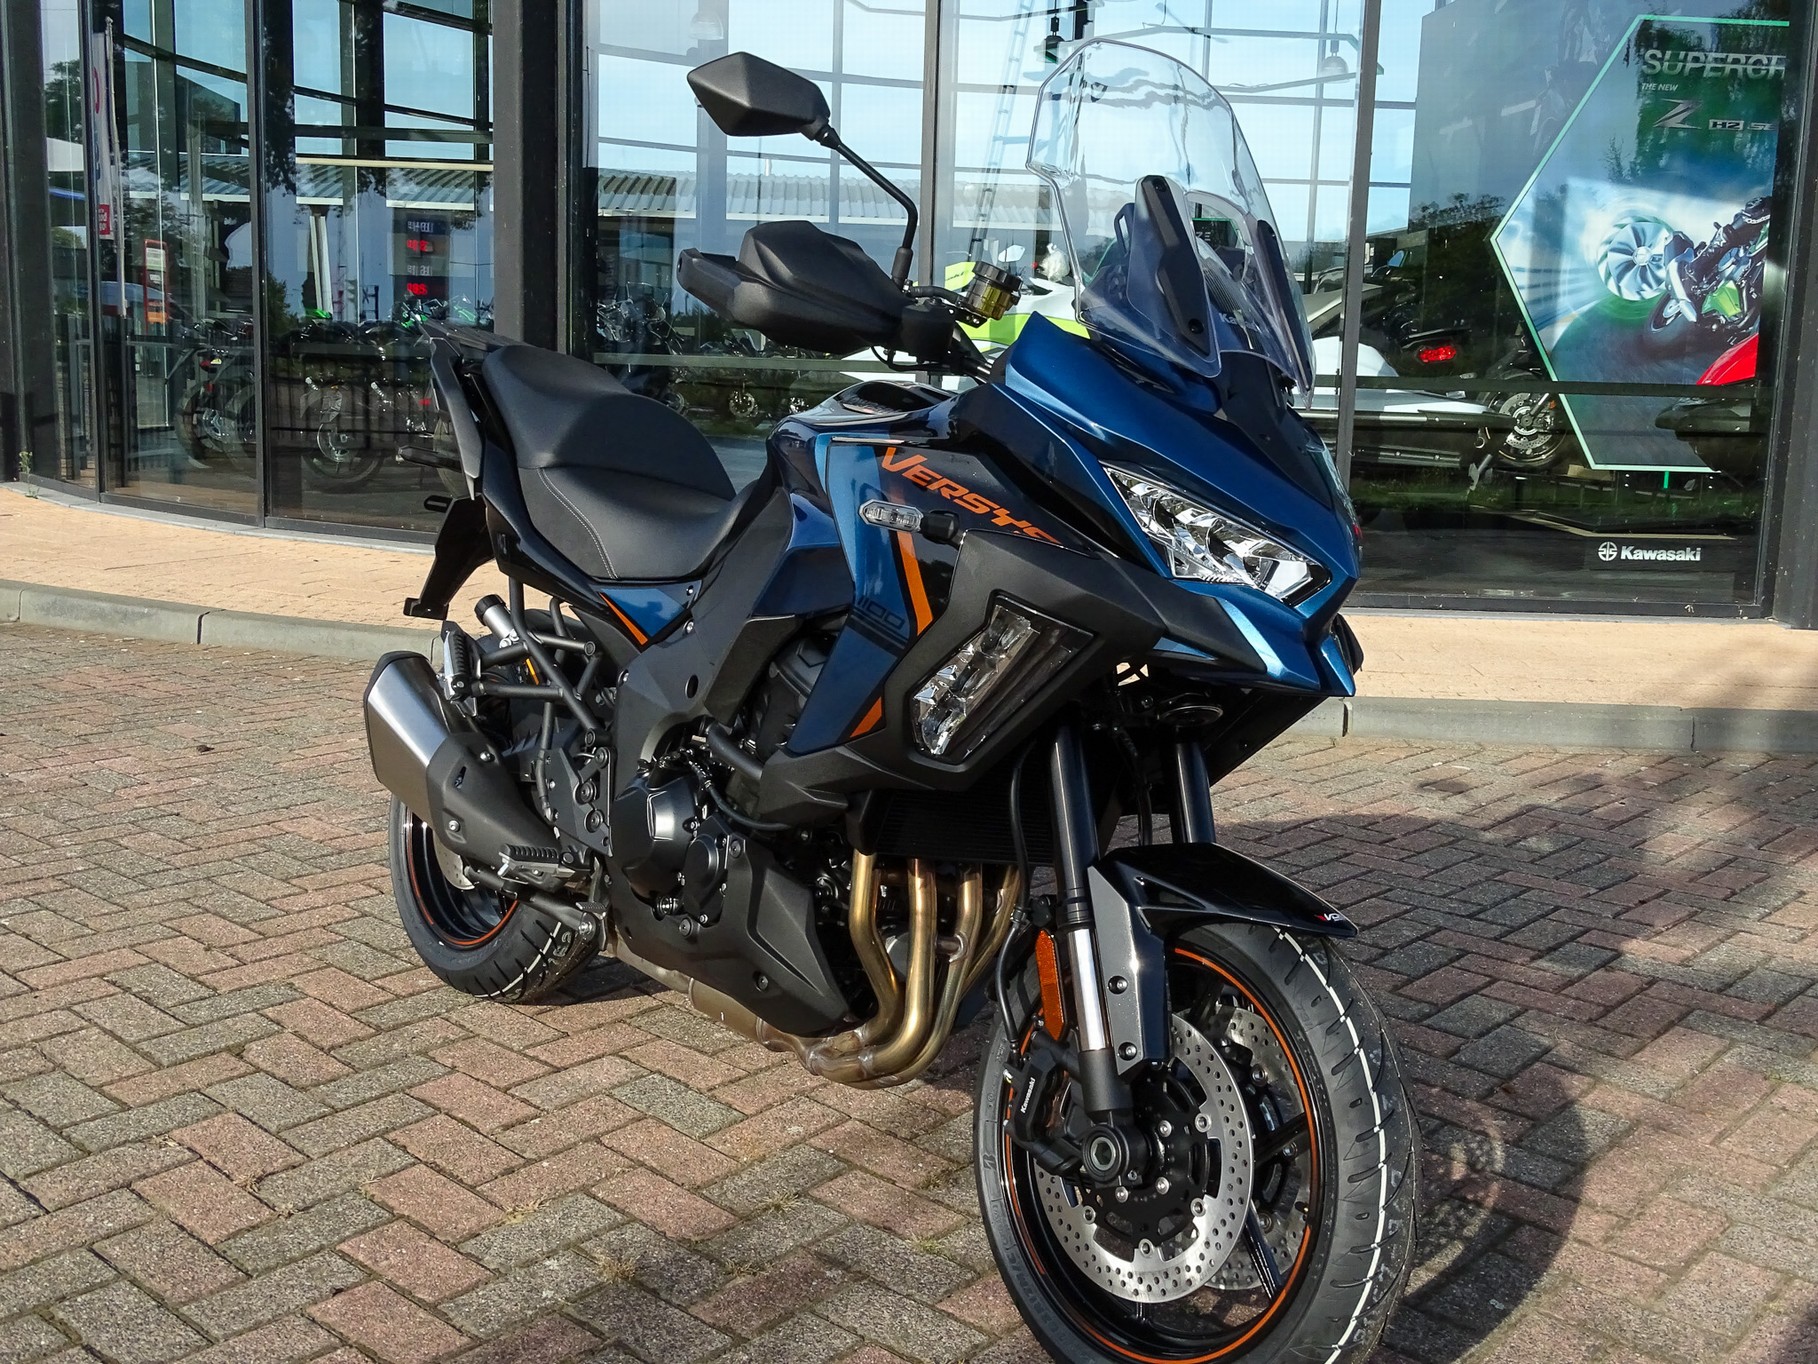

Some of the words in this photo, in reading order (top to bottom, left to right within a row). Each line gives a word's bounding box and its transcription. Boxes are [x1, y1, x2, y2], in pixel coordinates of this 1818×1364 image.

[1641, 82, 1657, 91] THE
[1658, 83, 1678, 92] NEW
[1711, 120, 1742, 130] H2
[1620, 545, 1701, 561] Kawasaki
[1020, 1076, 1036, 1114] Kawasaki
